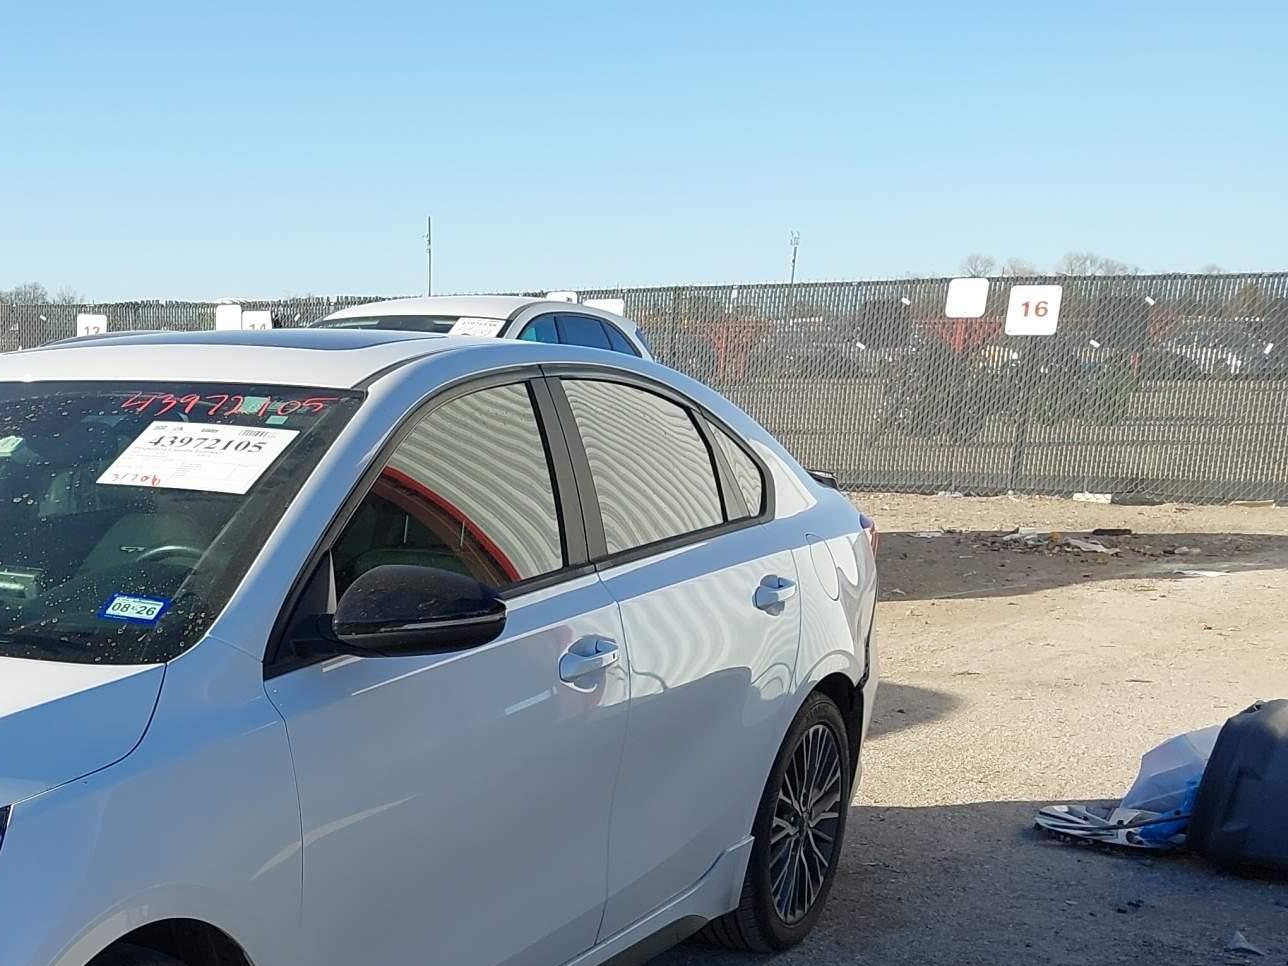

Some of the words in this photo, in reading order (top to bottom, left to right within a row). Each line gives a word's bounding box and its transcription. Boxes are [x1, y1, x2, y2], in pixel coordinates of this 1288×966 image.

[1022, 300, 1049, 318] 16
[121, 391, 339, 417] 43972105
[148, 434, 267, 454] 43972105
[111, 602, 131, 613] 08
[135, 605, 157, 616] 26
